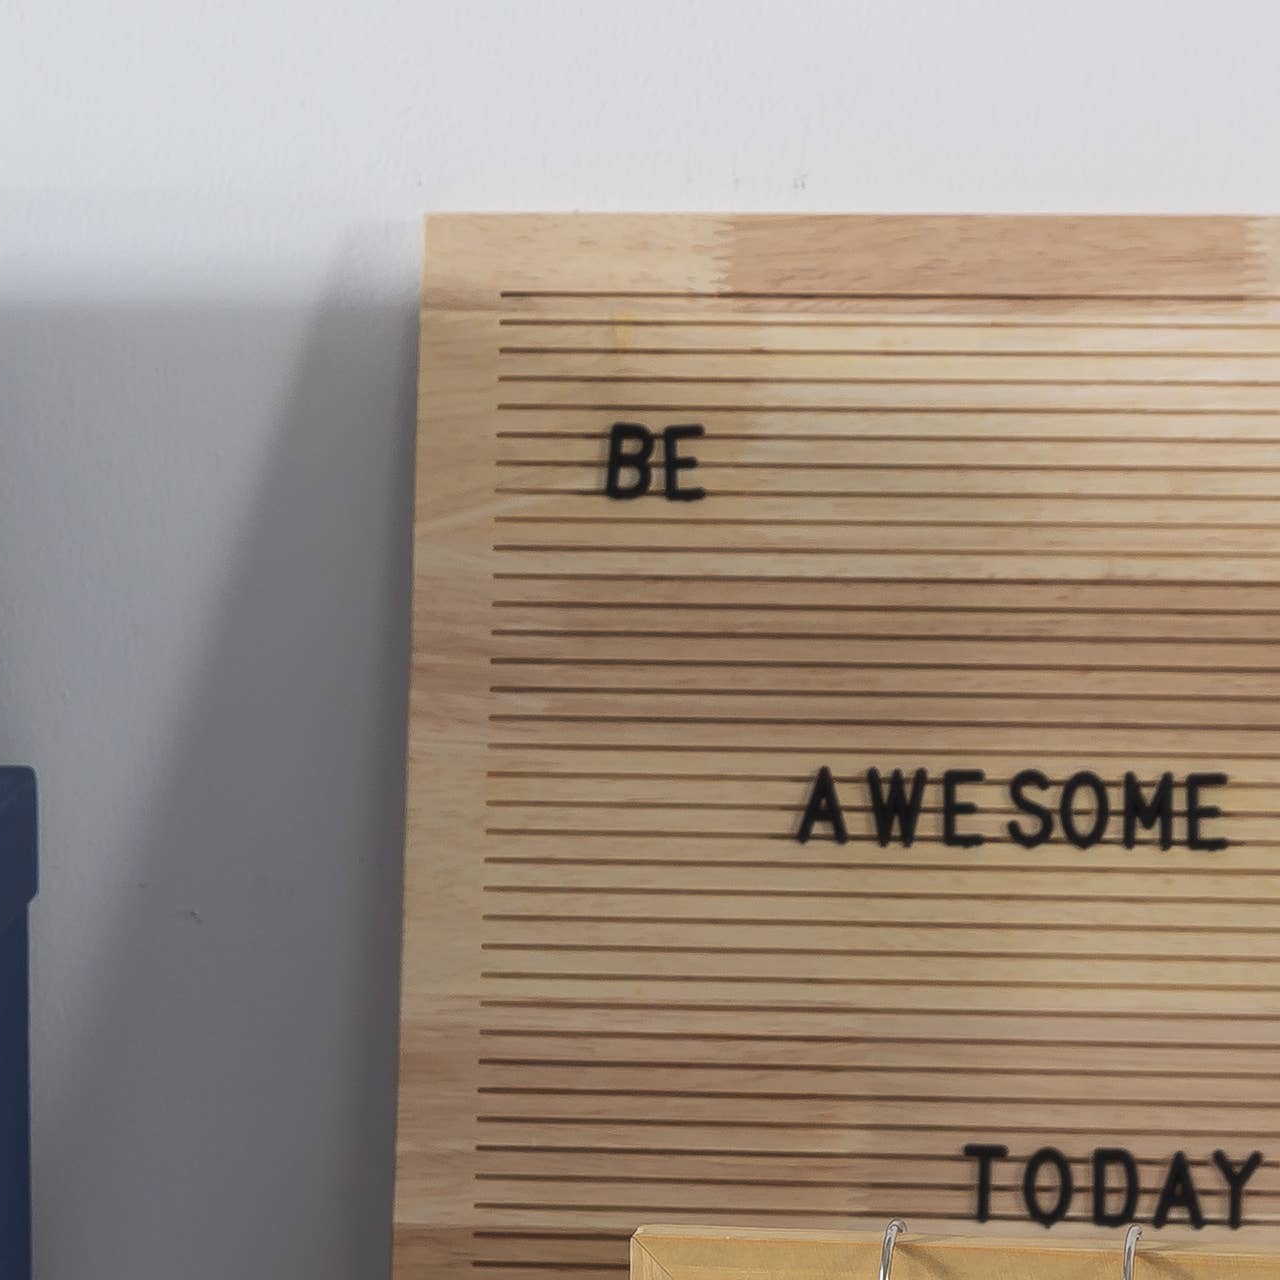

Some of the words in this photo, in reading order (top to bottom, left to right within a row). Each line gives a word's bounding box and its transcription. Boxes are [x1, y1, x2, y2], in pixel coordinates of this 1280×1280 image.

[605, 422, 707, 501] BE
[795, 766, 1228, 852] AWESOME
[963, 1143, 1265, 1228] TODAY
